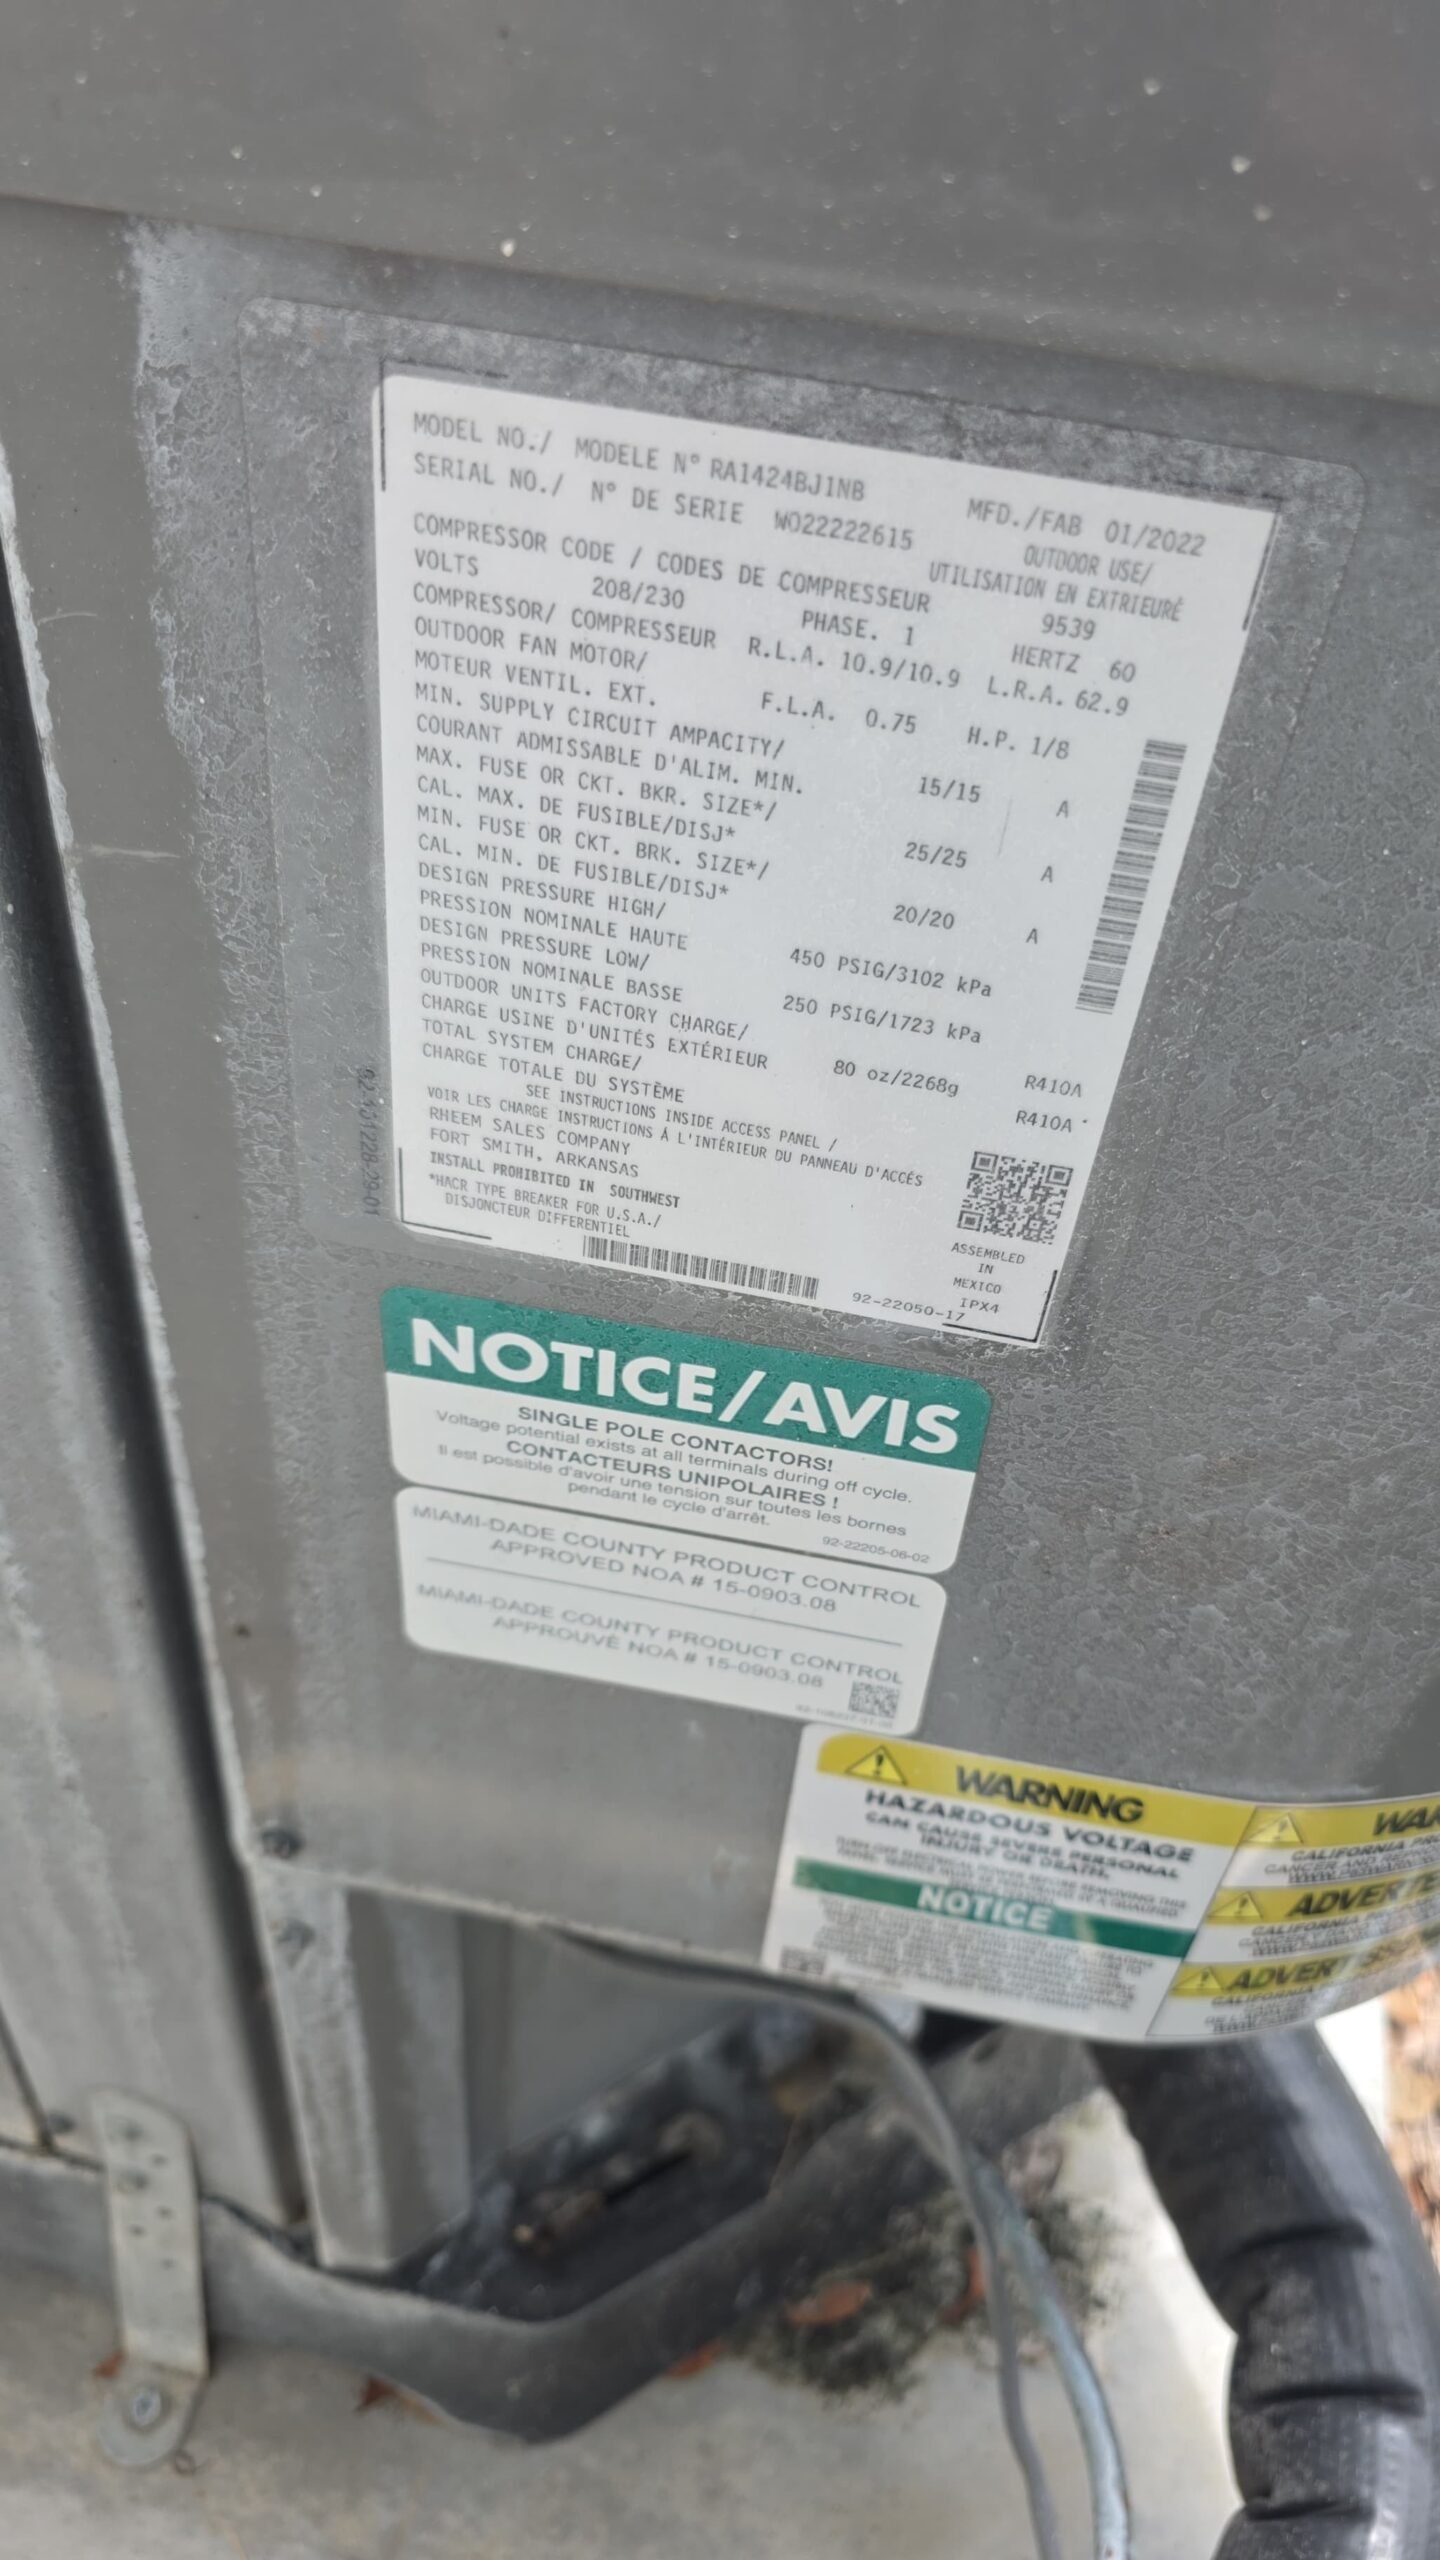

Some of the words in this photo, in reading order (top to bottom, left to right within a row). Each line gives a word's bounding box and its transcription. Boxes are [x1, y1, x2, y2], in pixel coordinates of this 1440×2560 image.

[413, 410, 482, 443] MODEL
[496, 422, 552, 456] NO./
[575, 435, 659, 471] MODELE
[709, 456, 866, 503] RA1424BJ1NB
[414, 451, 494, 486] SERIAL
[509, 465, 564, 498] NO./
[632, 486, 659, 512] DE
[674, 492, 744, 525] SERIE
[965, 495, 1085, 539] MFD./FAB
[1102, 518, 1207, 558] 01/2022
[414, 546, 478, 577] VOLTS
[414, 511, 546, 553] COMPRESSOR
[561, 535, 614, 564] CODE
[630, 545, 642, 570] /
[656, 550, 724, 582] CODES
[738, 563, 765, 587] DE
[776, 568, 931, 614] COMPRESSEUR
[927, 560, 1047, 600] UTILISATION
[1054, 581, 1079, 605] EN
[1022, 543, 1102, 577] OUTDOOR
[1106, 557, 1154, 587] USE/
[413, 580, 555, 625] COMPRESSOR/
[571, 606, 717, 650] COMPRESSEUR
[591, 574, 685, 612] 208/230
[414, 614, 504, 649] OUTDOOR
[519, 632, 556, 657] FAN
[569, 639, 648, 673] MOTOR/
[801, 609, 879, 641] PHASE.
[904, 625, 914, 646] 1
[1039, 612, 1097, 641] 9539
[748, 635, 825, 667] R.L.A.
[841, 649, 961, 690] 10.9/10.9
[1011, 643, 1081, 674] HERTZ
[1107, 659, 1138, 683] 60
[761, 691, 836, 721] F.L.A.
[864, 707, 917, 735] 0.75
[987, 674, 1066, 706] L.R.A.
[1073, 688, 1130, 717] 62.9
[415, 681, 461, 707] MIN.
[480, 691, 553, 722] SUPPLY
[567, 705, 656, 739] CIRCUIT
[669, 721, 784, 761] AMPACITY/
[966, 725, 1018, 751] H.P.
[1030, 735, 1071, 761] 1/8
[416, 744, 461, 769] MAX.
[479, 754, 526, 779] FUSE
[540, 764, 564, 786] OR
[577, 770, 624, 796] CKT.
[639, 781, 687, 807] BKR.
[918, 774, 982, 804] 15/15
[1055, 799, 1071, 818] A
[904, 840, 968, 870] 25/25
[1040, 864, 1056, 883] A
[419, 860, 487, 888] DESIGN
[502, 875, 594, 907] PRESSURE
[608, 893, 666, 920] HIGH/
[892, 902, 956, 932] 20/20
[1025, 927, 1040, 944] A
[789, 946, 825, 969] 450
[837, 954, 944, 990] PSIG/3102
[956, 975, 993, 997] kPa
[420, 967, 498, 995] OUTDOOR
[511, 983, 566, 1008] UNITS
[579, 995, 657, 1024] FACTORY
[669, 1010, 748, 1041] CHARGE/
[783, 993, 818, 1015] 250
[829, 1001, 935, 1036] PSIG/1723
[946, 1022, 982, 1043] kPa
[422, 1017, 474, 1040] TOTAL
[488, 1029, 553, 1055] SYSTEM
[566, 1042, 642, 1072] CHARGE/
[832, 1058, 856, 1077] 80
[865, 1063, 960, 1098] oz/2268g
[1024, 1074, 1084, 1098] R410A
[429, 1105, 481, 1128] RHEEM
[493, 1117, 544, 1140] SALES
[557, 1129, 630, 1156] COMPANY
[526, 1083, 549, 1100] SEE
[560, 1089, 656, 1119] INSTRUCTIONS
[666, 1108, 714, 1129] INSIDE
[721, 1118, 771, 1140] ACCESS
[779, 1129, 821, 1149] PANEL
[828, 1137, 837, 1153] /
[1015, 1109, 1074, 1133] R410A
[430, 1126, 469, 1146] FORT
[482, 1136, 542, 1162] SMITH,
[555, 1149, 639, 1178] ARKANSAS
[431, 1150, 484, 1172] INSTALL
[493, 1162, 570, 1188] PROHIBITED
[579, 1178, 594, 1192] IN
[609, 1183, 680, 1209] SOUTHWEST
[445, 1191, 530, 1219] DISJONCTEUR
[537, 1208, 630, 1238] DIFFERENTIEL
[476, 1181, 506, 1199] TYPE
[514, 1188, 568, 1210] BREAKER
[576, 1200, 599, 1216] FOR
[606, 1204, 661, 1229] U.S.A./
[950, 1241, 1025, 1265] ASSEMBLED
[978, 1263, 994, 1274] IN
[851, 1291, 965, 1322] 92-22050-17
[953, 1276, 1002, 1294] MEXICO
[960, 1297, 1000, 1314] IPX4
[413, 1317, 962, 1455] NOTICE/AVIS
[436, 1410, 500, 1434] Voltage
[506, 1421, 579, 1447] potential
[585, 1434, 636, 1455] exists
[641, 1445, 657, 1458] at
[663, 1448, 682, 1462] all
[687, 1452, 768, 1477] terminals
[772, 1467, 829, 1491] during
[833, 1477, 857, 1493] off
[861, 1483, 913, 1505] cycle.
[518, 1406, 597, 1432] SINGLE
[605, 1420, 663, 1443] POLE
[670, 1431, 833, 1472] CONTACTORS!
[506, 1439, 671, 1480] CONTACTEURS
[678, 1469, 826, 1507] UNIPOLAIRES
[567, 1479, 636, 1504] pendant
[642, 1493, 657, 1506] le
[662, 1496, 706, 1517] cycle
[711, 1504, 770, 1526] d'arrêt.
[413, 1504, 554, 1541] MIAMI-DADE
[563, 1530, 666, 1562] COUNTY
[673, 1550, 795, 1585] PRODUCT
[801, 1573, 921, 1608] CONTROL
[490, 1537, 624, 1573] APPROVED
[632, 1563, 685, 1584] NOA
[690, 1573, 704, 1588] #
[713, 1577, 837, 1613] 15-0903.08
[954, 1766, 1146, 1824] WARNING
[864, 1789, 1054, 1838] HAZARDOUS
[1059, 1826, 1195, 1863] VOLTAGE
[916, 1883, 1053, 1930] NOTICE
